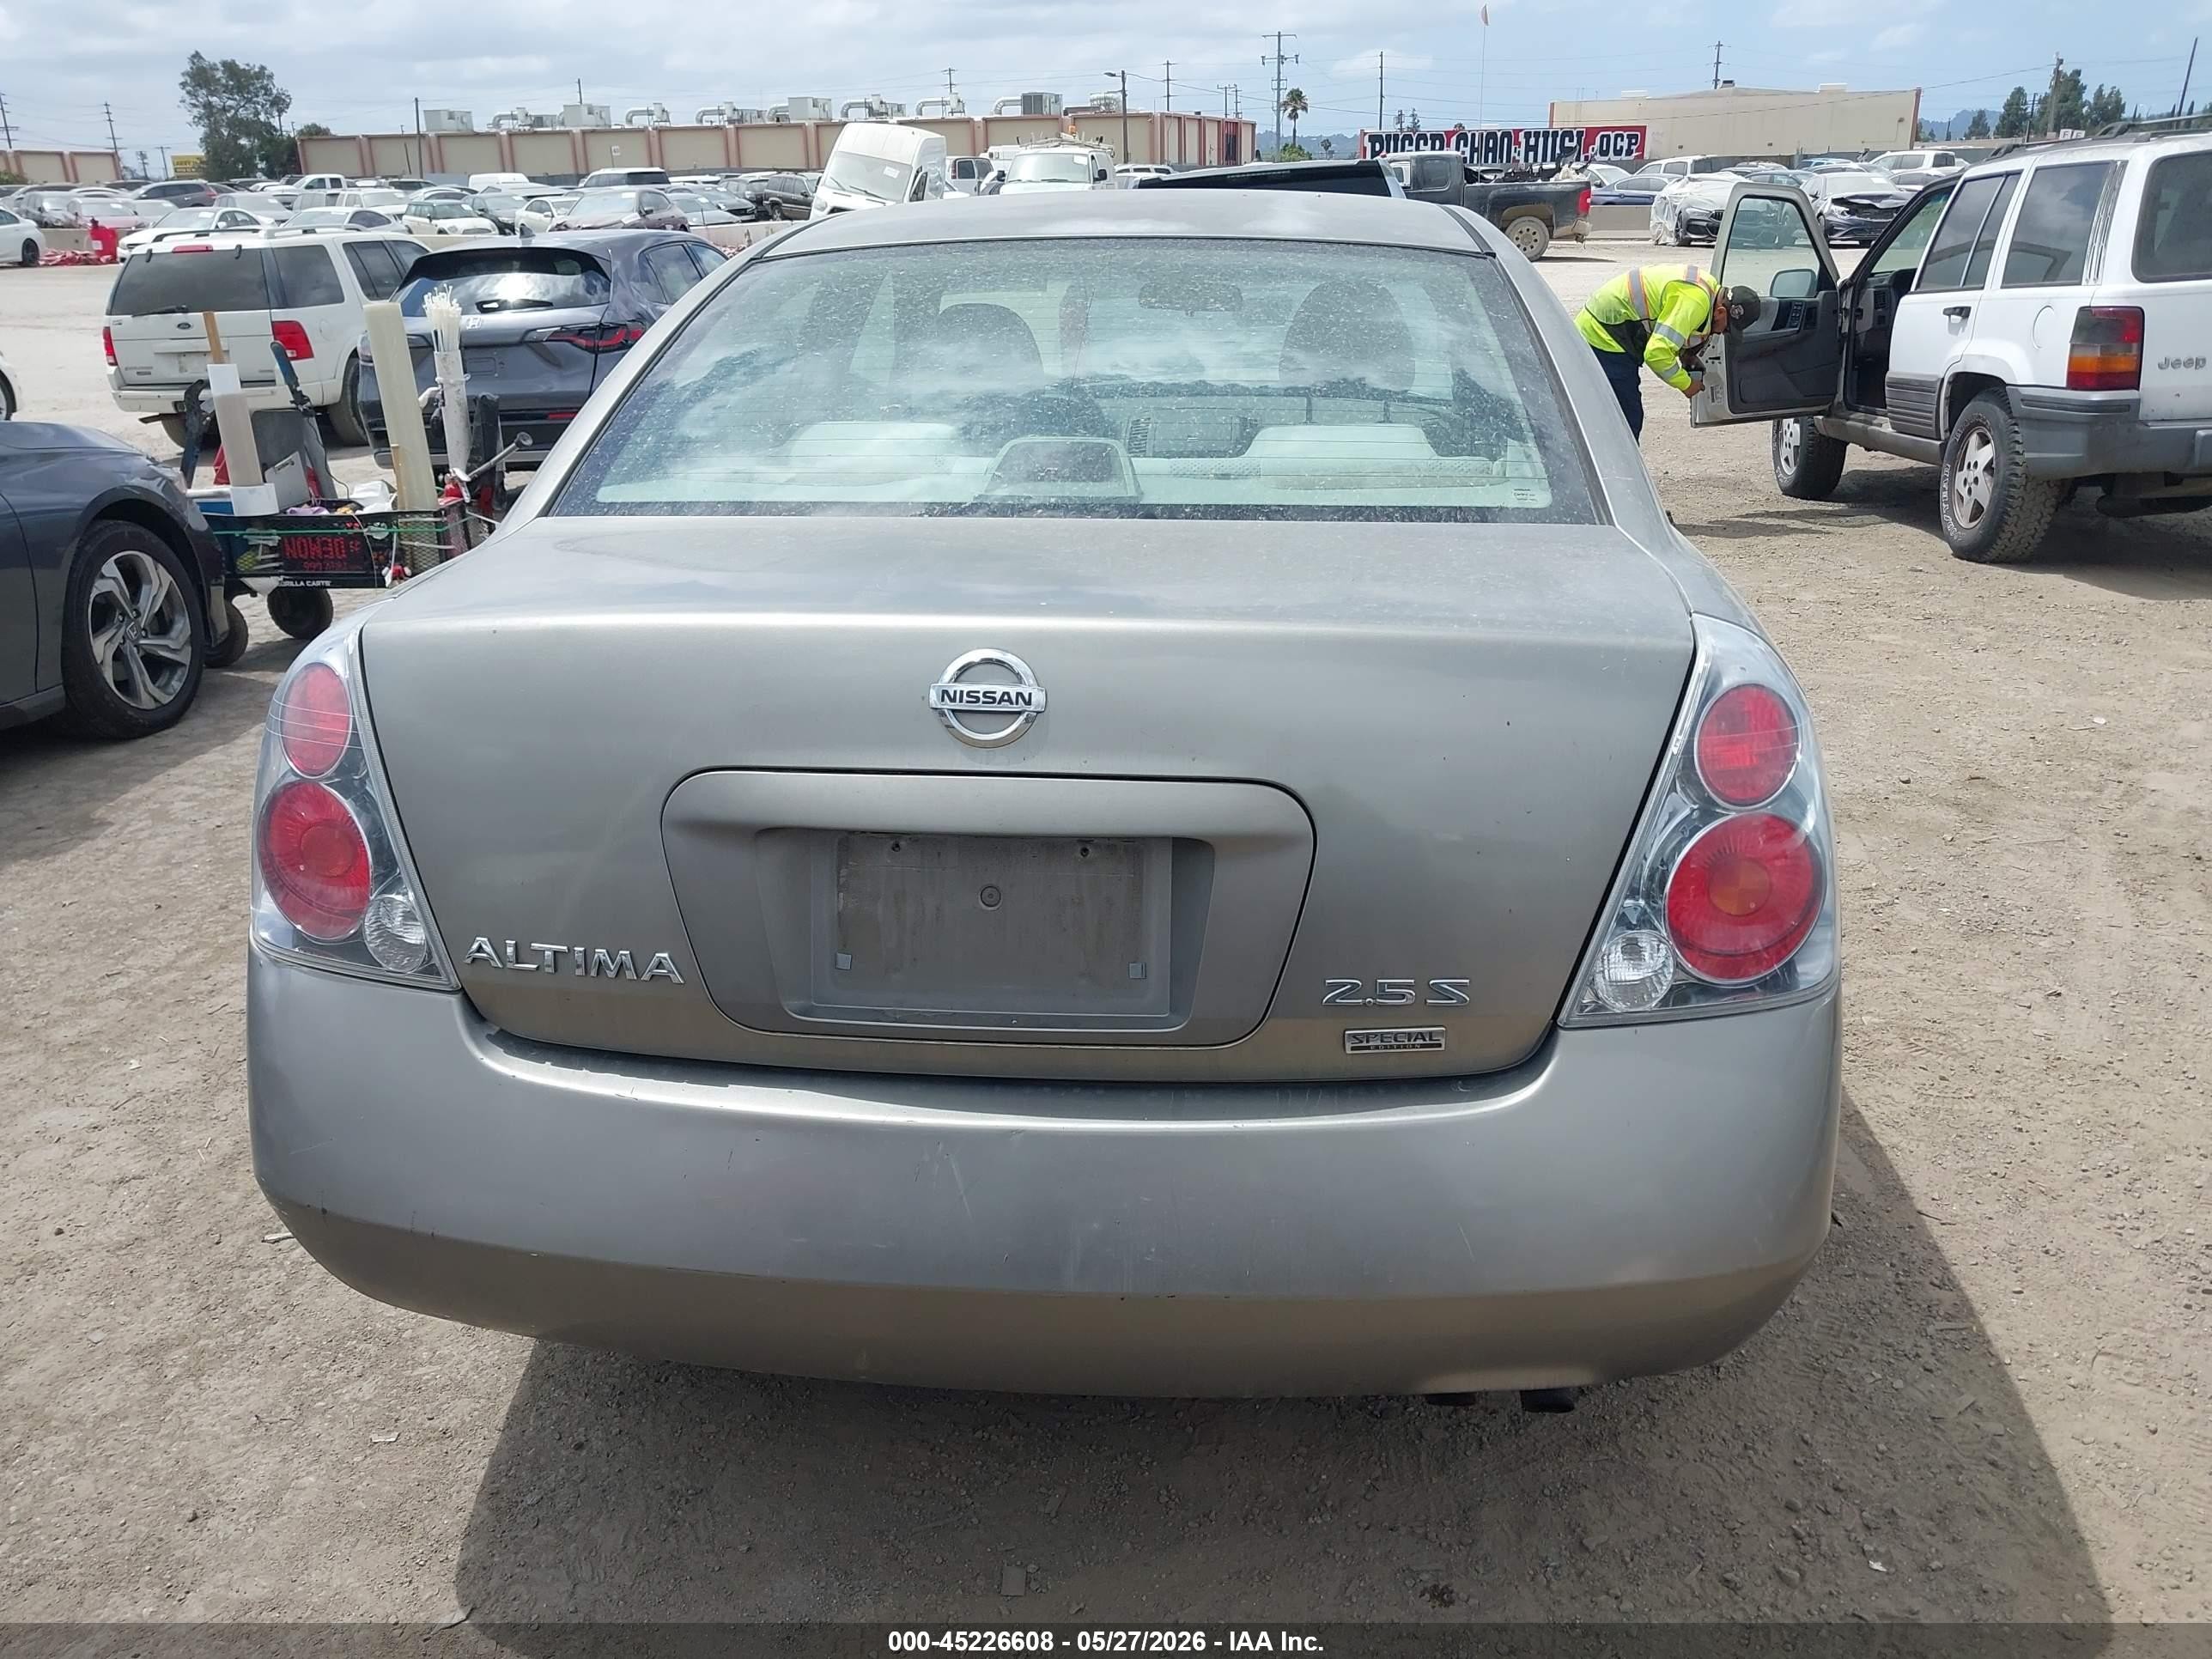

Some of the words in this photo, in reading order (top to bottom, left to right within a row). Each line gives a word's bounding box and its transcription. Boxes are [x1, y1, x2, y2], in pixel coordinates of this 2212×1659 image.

[2157, 356, 2206, 370] Jeep
[940, 689, 1033, 706] NISSAN
[463, 937, 685, 984] ALTIMA
[1322, 979, 1416, 1006] 2.5
[1424, 979, 1471, 1006] S
[1351, 1031, 1442, 1045] SPECIAL
